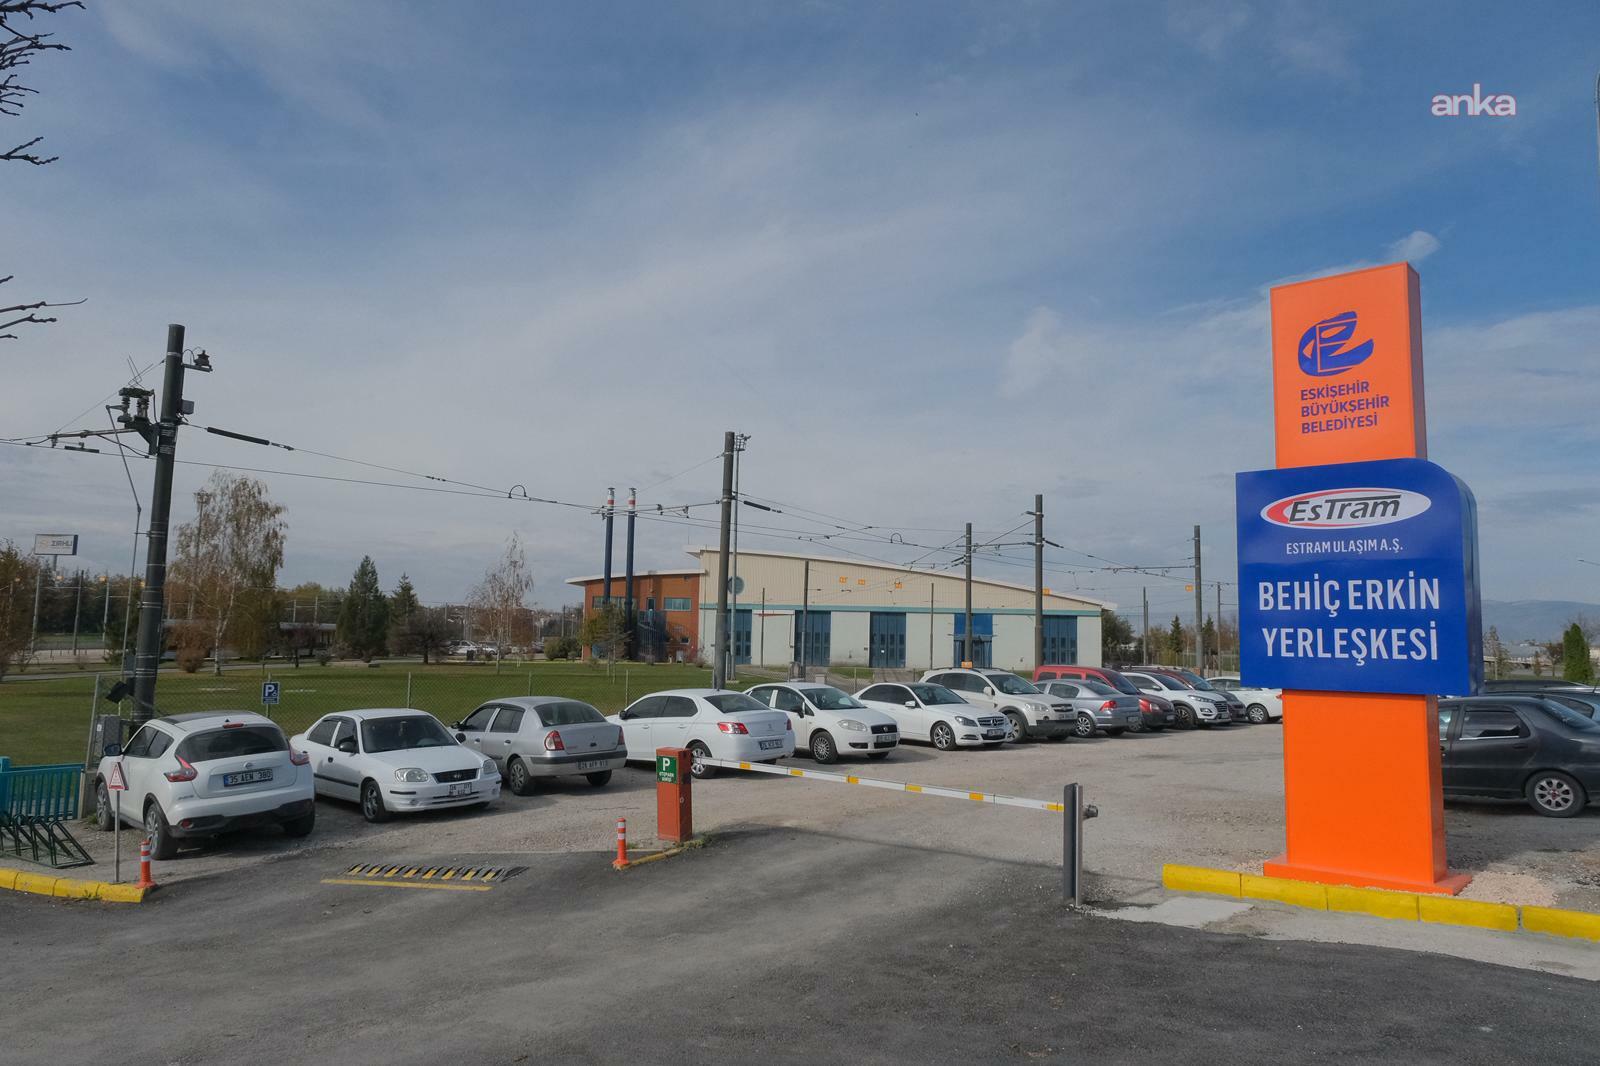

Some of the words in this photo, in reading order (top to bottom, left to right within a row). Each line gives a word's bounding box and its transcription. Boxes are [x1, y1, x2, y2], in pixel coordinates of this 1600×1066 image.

[1301, 380, 1370, 401] ESKİŞEHİR
[1301, 395, 1390, 418] BÜYÜKŞEHİR
[1301, 412, 1378, 434] BELEDİYESİ
[1289, 494, 1402, 522] EsTram
[1286, 541, 1331, 555] ESTRAM
[1333, 540, 1378, 555] ULAŞIM
[1258, 573, 1340, 618] BEHİÇ
[1347, 571, 1440, 610] ERKİN
[1261, 621, 1439, 667] YERLEŞKESİ
[265, 684, 275, 697] P
[662, 757, 671, 772] P
